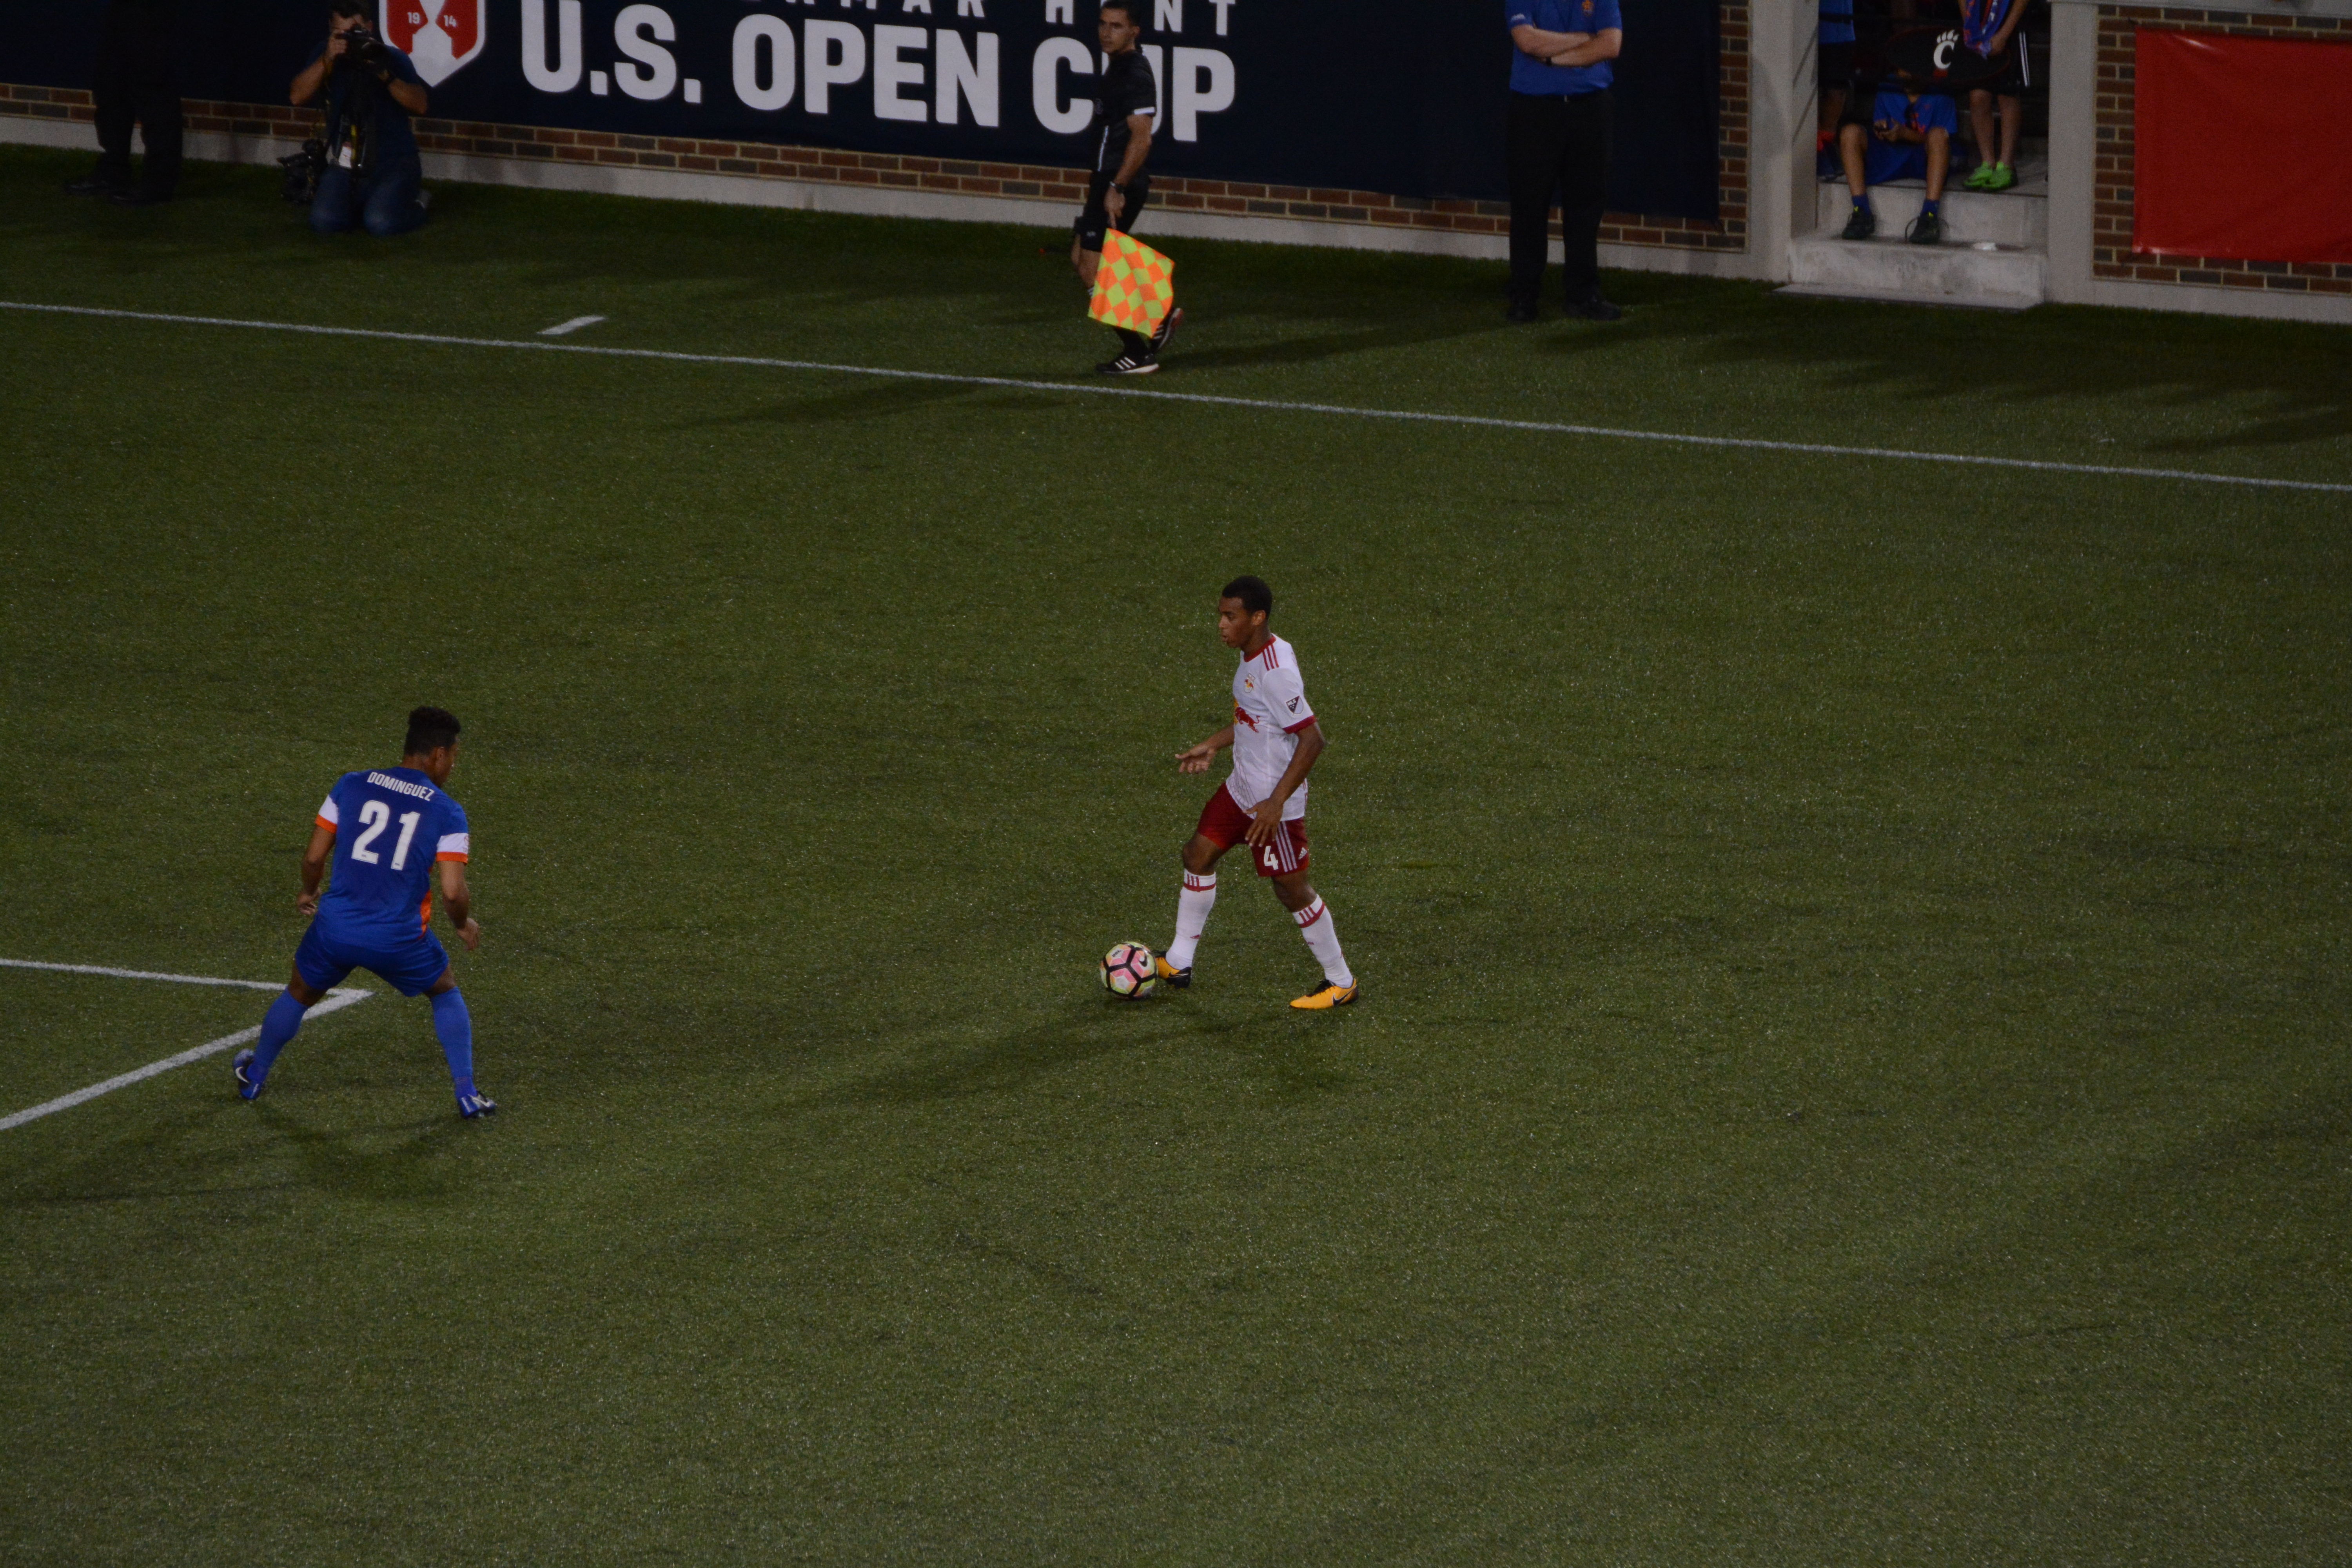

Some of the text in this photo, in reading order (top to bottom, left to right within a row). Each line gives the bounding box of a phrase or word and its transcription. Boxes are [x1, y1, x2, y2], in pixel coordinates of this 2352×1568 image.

[407, 12, 457, 27] 19 14
[1045, 0, 1236, 36] HNT
[521, 0, 702, 103] U.S.
[732, 14, 999, 127] OPEN
[367, 771, 435, 802] DOMINGUEZ
[351, 800, 421, 871] 21
[1263, 846, 1278, 870] 4
